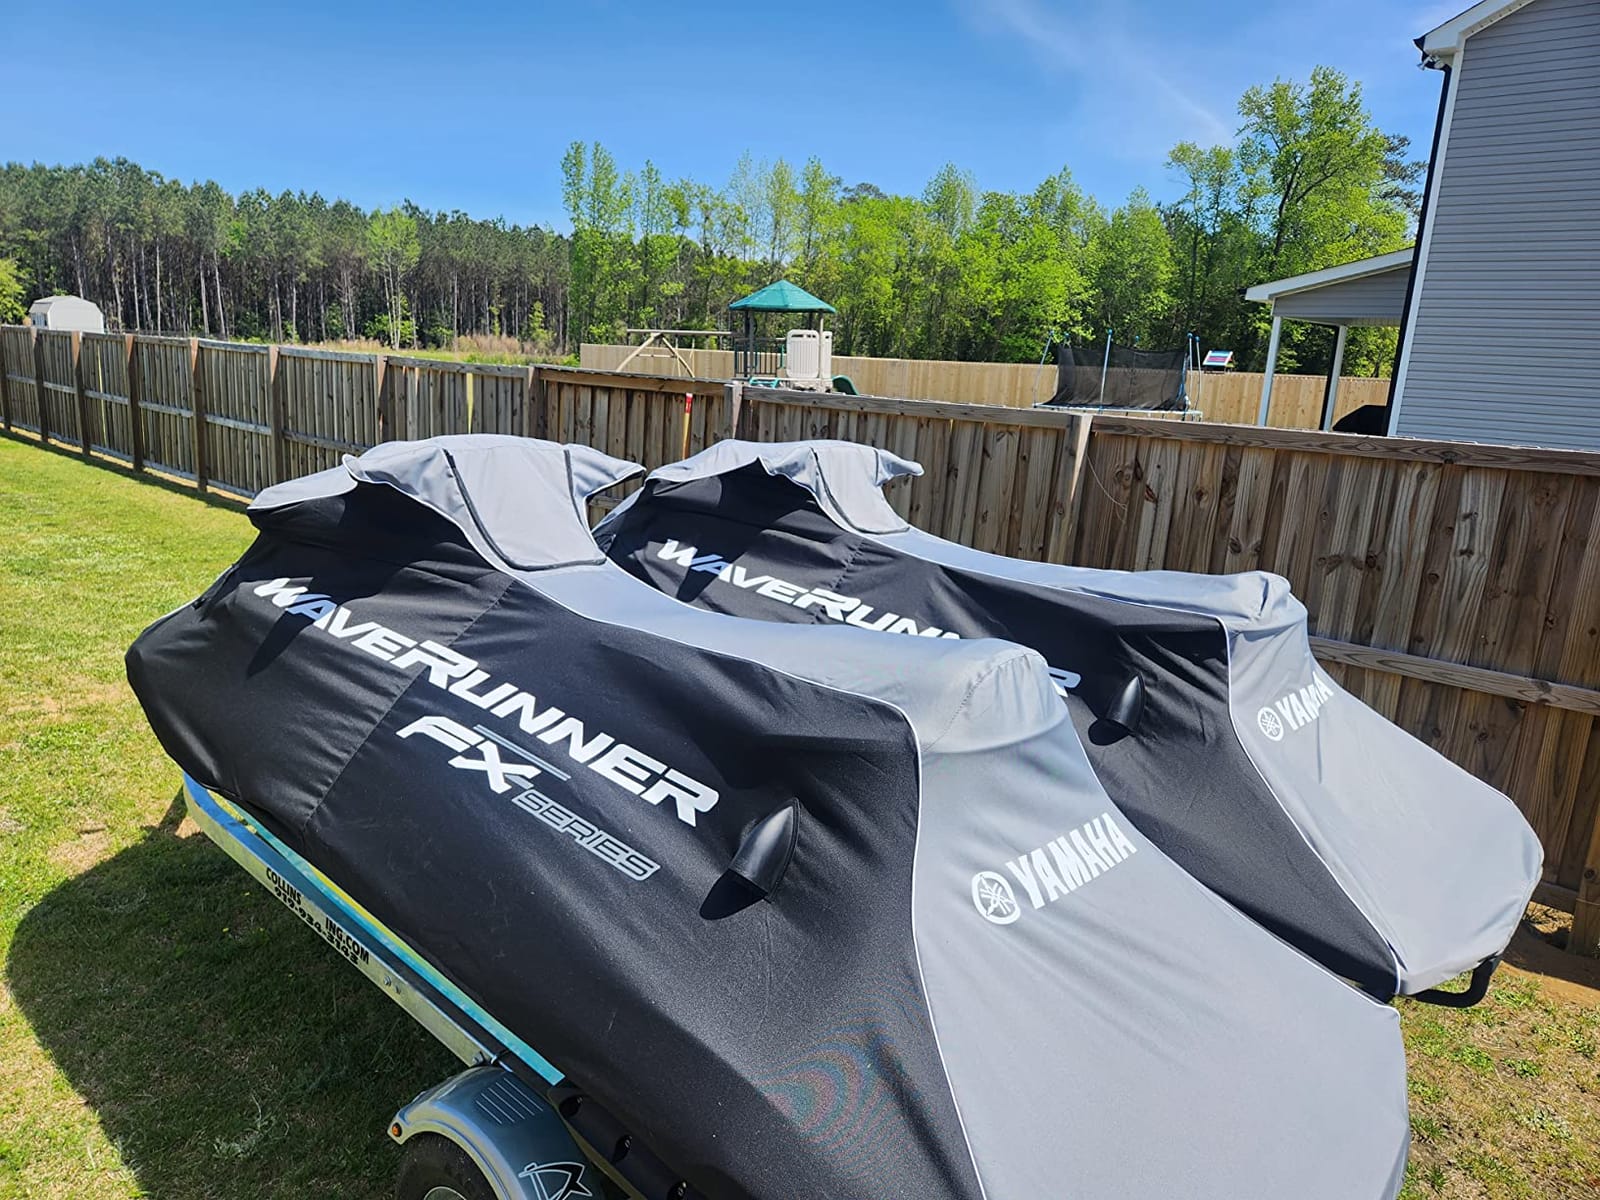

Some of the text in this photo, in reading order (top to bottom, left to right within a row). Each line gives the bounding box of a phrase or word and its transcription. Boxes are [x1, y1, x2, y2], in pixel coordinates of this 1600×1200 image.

[253, 577, 720, 828] WAVERUNNER
[396, 715, 661, 882] FX SERIES
[1005, 812, 1138, 910] YAMAHA
[265, 867, 303, 906] COLLINS
